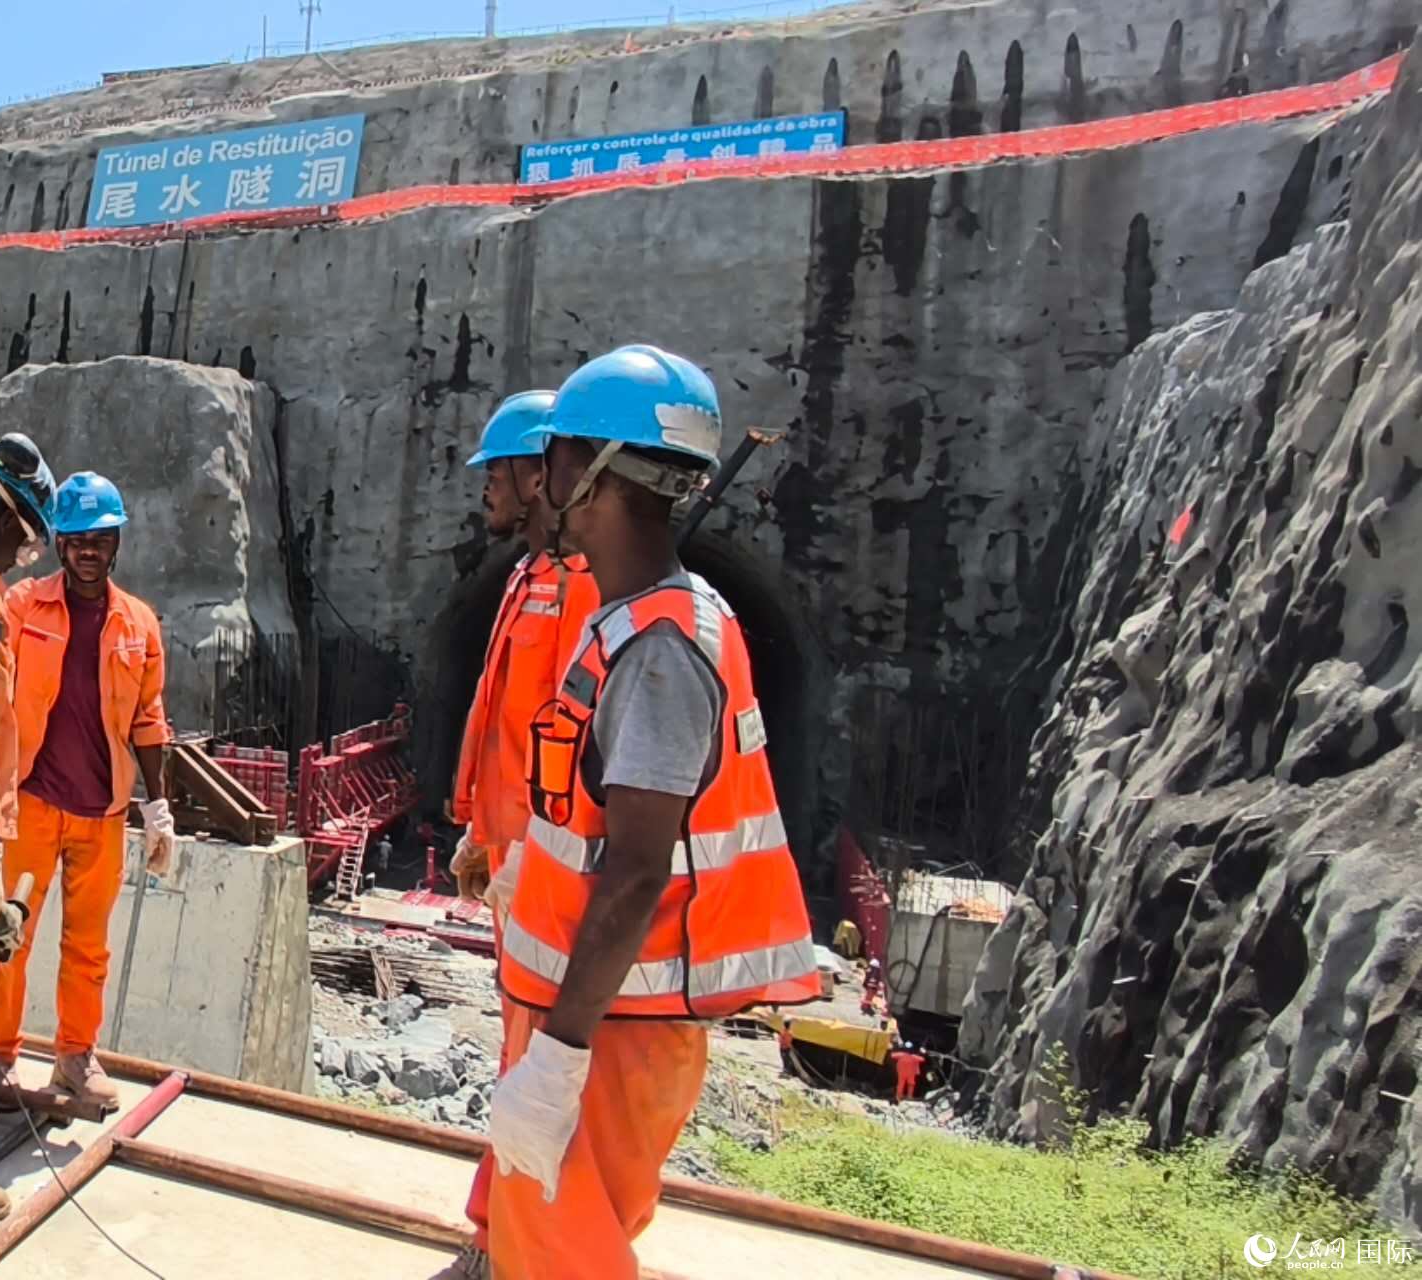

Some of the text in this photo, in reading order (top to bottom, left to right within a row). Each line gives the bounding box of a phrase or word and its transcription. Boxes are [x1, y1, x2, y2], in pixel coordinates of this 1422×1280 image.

[103, 126, 354, 175] Túnel de Restituição
[527, 116, 837, 157] Reforçar o controle de qualidade da obra
[95, 156, 346, 219] 尾水隧洞
